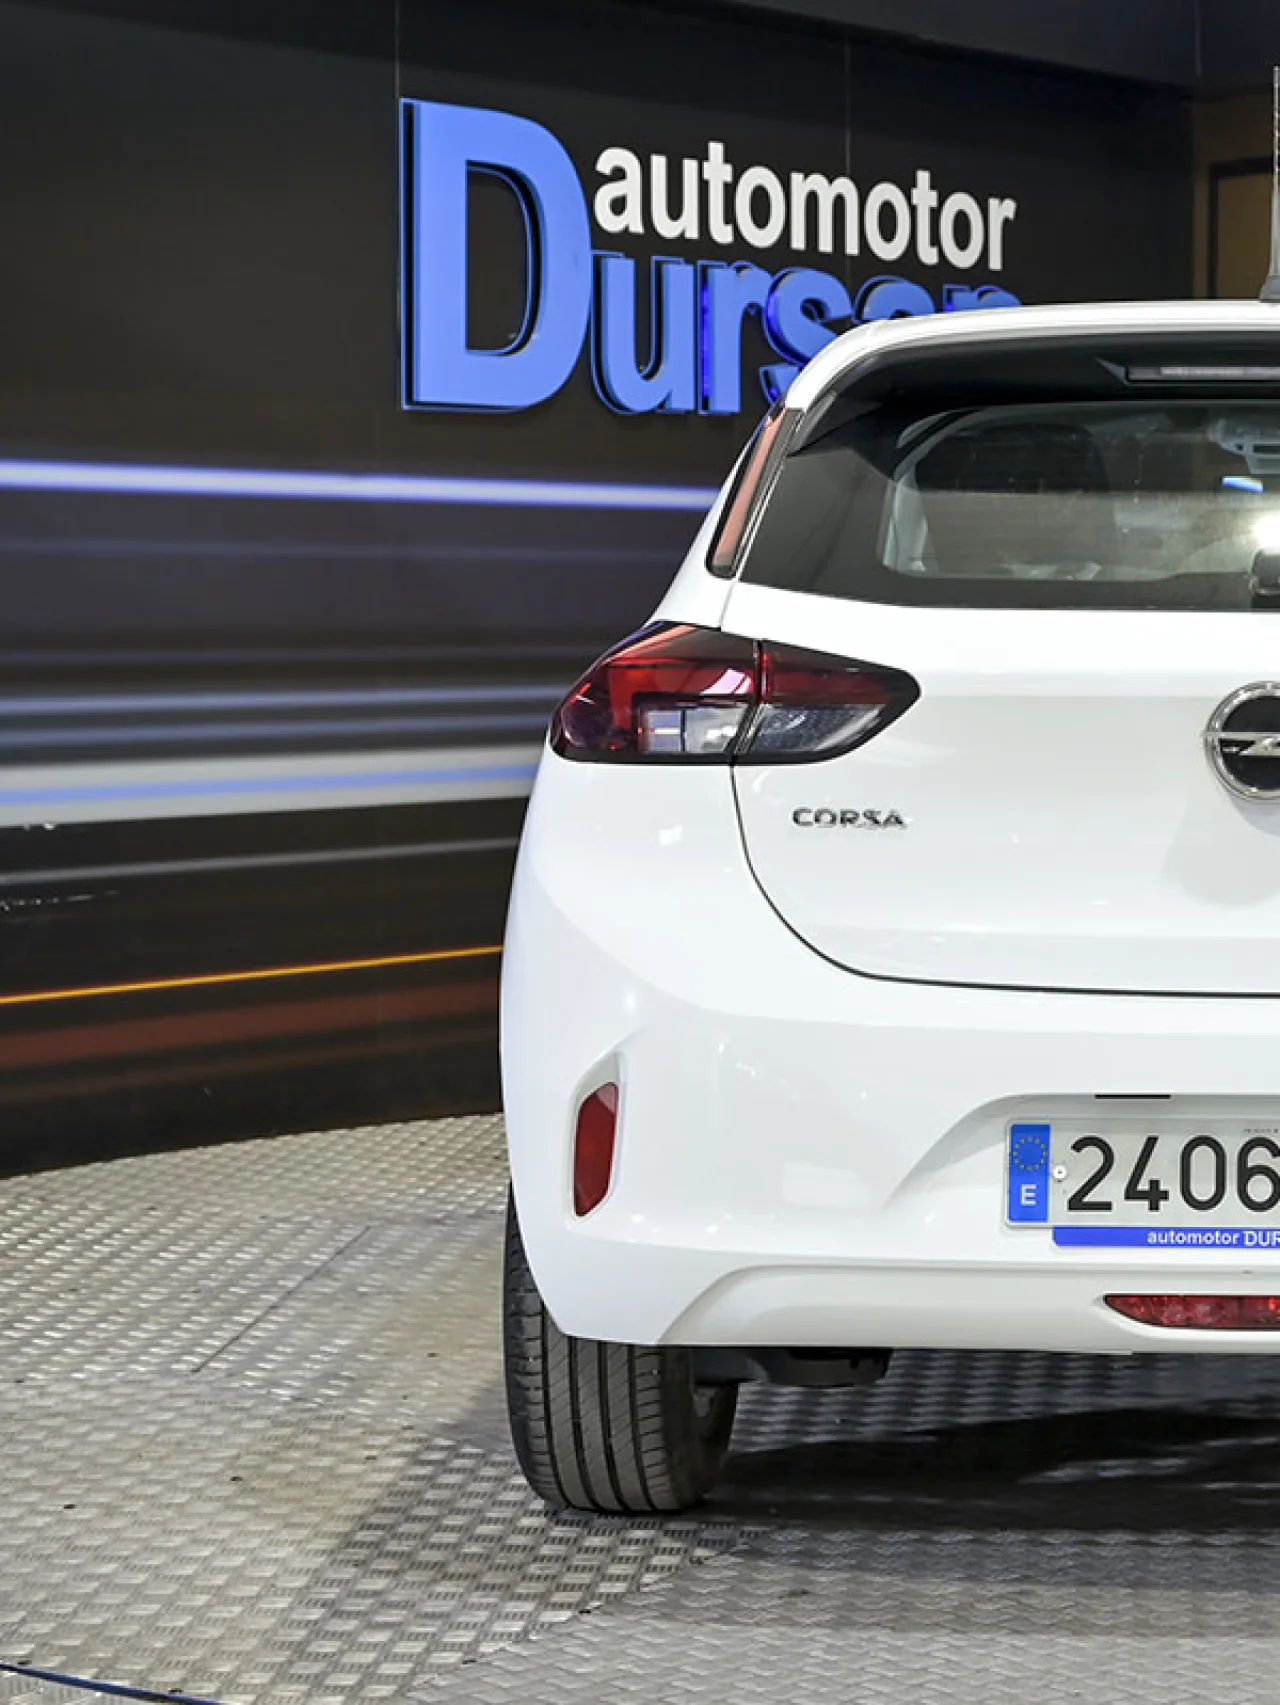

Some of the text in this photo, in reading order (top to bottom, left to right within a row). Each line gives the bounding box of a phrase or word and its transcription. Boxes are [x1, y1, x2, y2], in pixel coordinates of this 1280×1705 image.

[594, 141, 1017, 271] automotor
[400, 97, 1022, 414] Durs
[792, 808, 906, 830] CORSA
[1020, 1183, 1038, 1206] E
[1147, 1230, 1240, 1246] automotor
